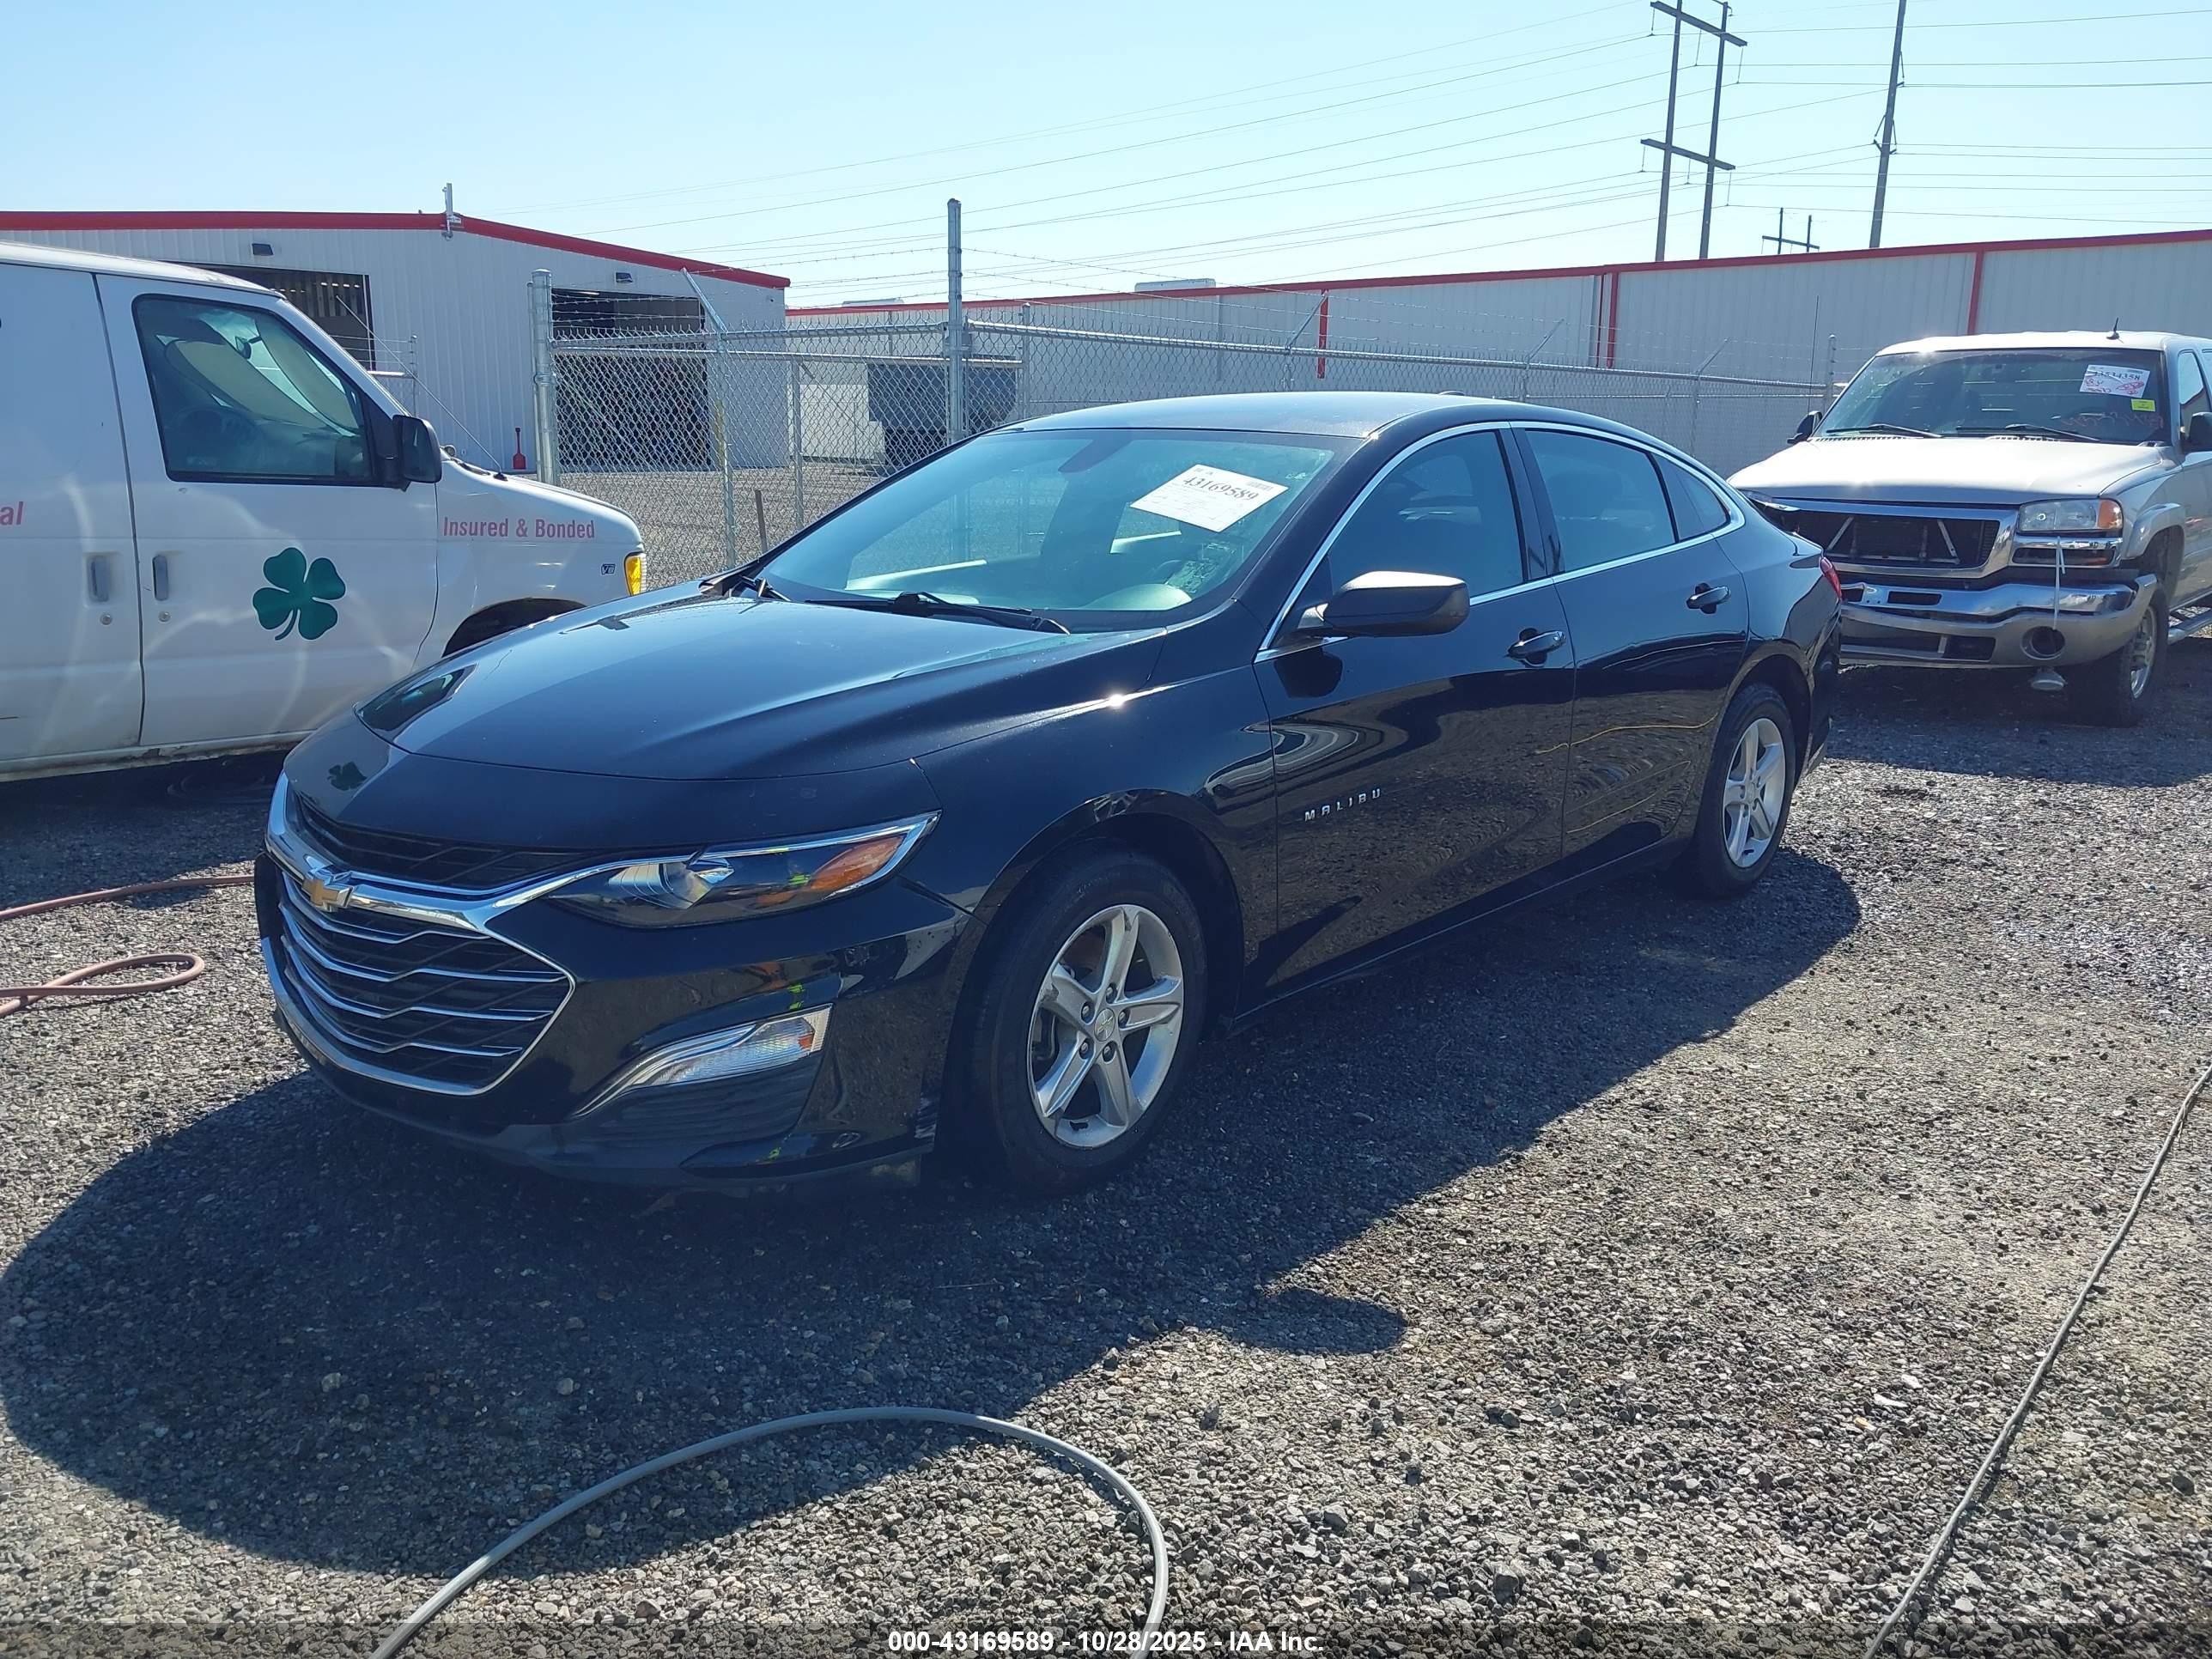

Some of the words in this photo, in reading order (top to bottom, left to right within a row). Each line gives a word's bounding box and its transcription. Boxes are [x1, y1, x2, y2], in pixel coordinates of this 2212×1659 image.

[1182, 476, 1260, 501] 43169589
[443, 517, 508, 538] Insured
[515, 518, 528, 538] &
[535, 519, 595, 539] Bonded
[1304, 788, 1381, 822] MALIBU
